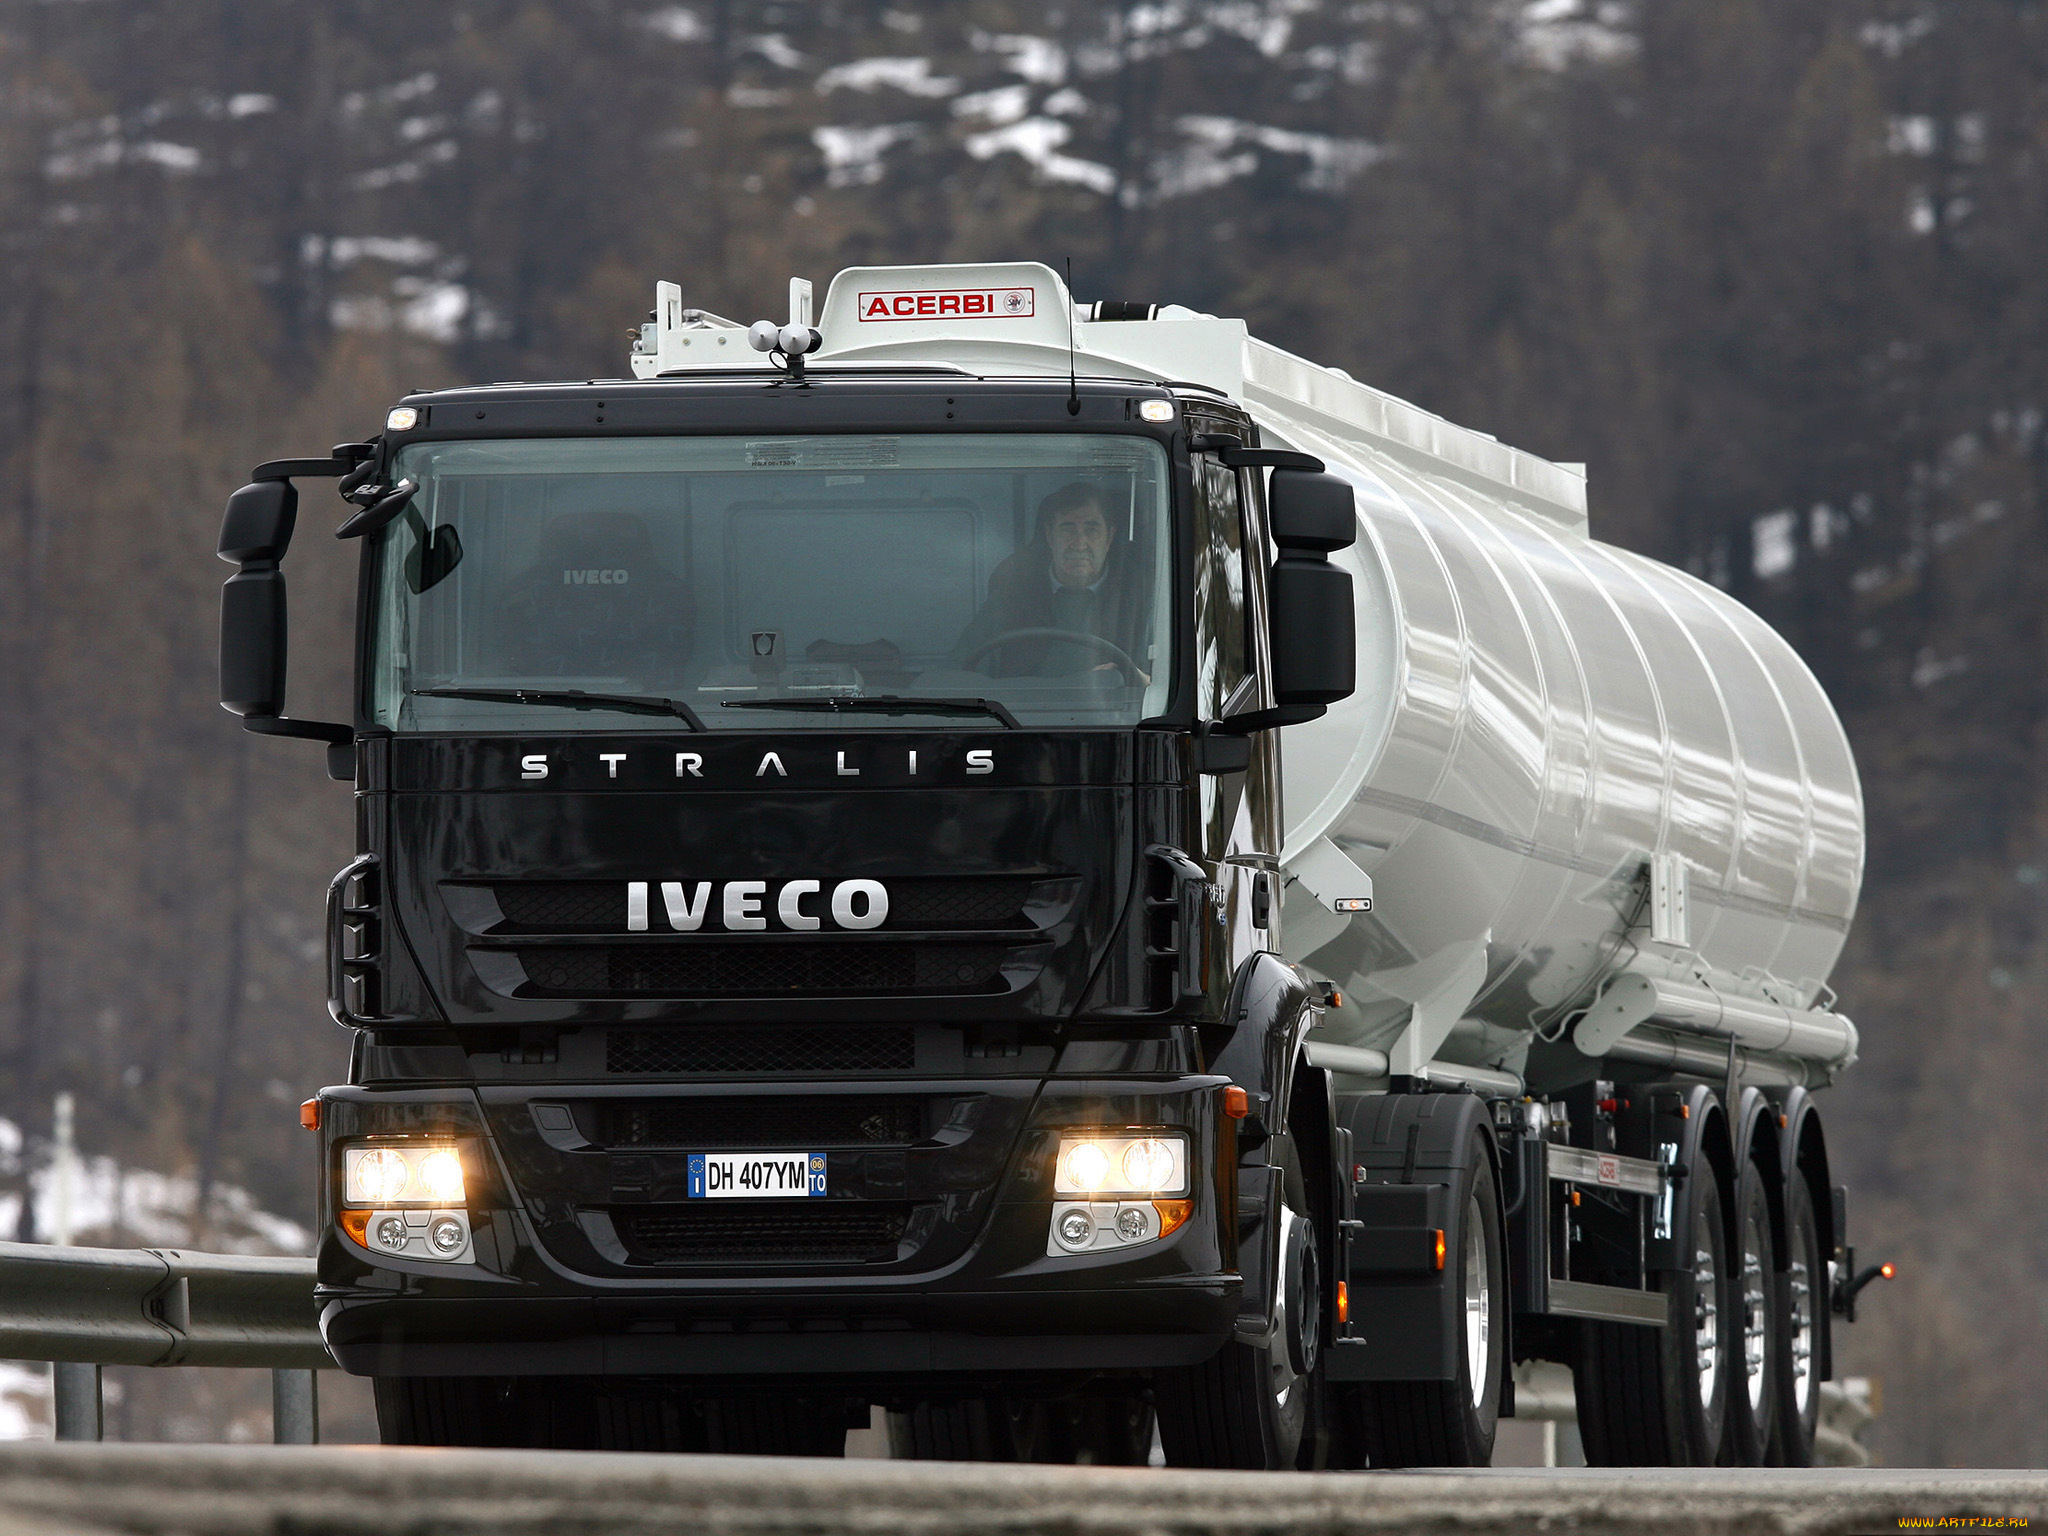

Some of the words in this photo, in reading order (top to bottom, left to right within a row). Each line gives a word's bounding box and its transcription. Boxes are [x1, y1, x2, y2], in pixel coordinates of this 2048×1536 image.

[866, 294, 994, 317] ACERBI
[563, 569, 629, 585] IVECO
[520, 750, 995, 779] STRALIS
[627, 879, 889, 931] IVECO
[708, 1162, 733, 1190] DH
[739, 1161, 805, 1190] 407YM
[809, 1174, 826, 1192] TO
